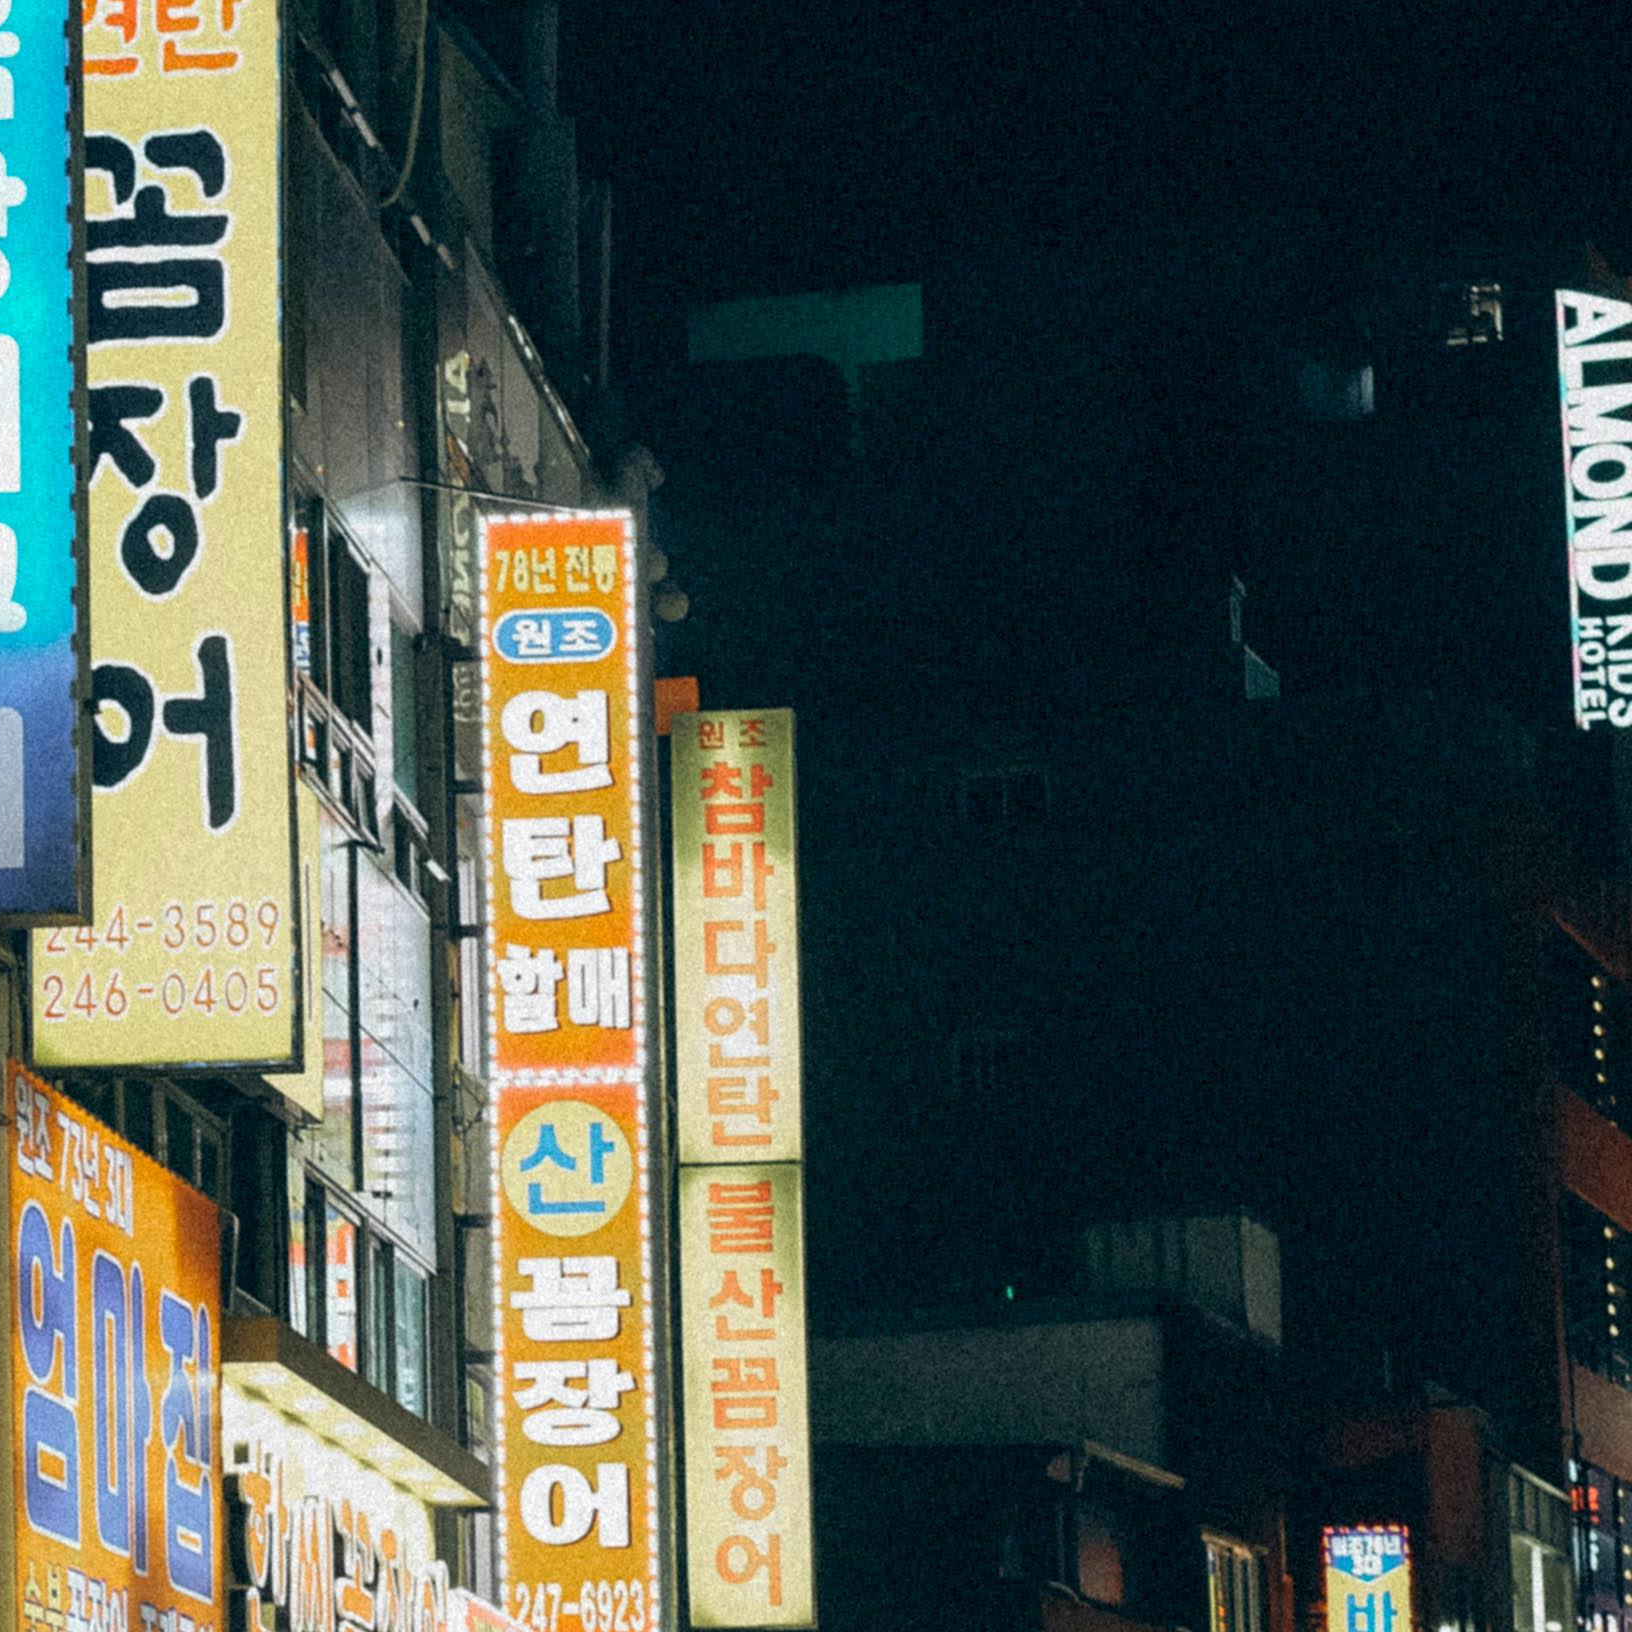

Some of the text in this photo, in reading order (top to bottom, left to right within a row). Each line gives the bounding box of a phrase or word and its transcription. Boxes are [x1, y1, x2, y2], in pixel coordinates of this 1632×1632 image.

[1563, 288, 1632, 601] ALMOND
[494, 540, 618, 598] 78년 전통
[510, 615, 604, 658] 원조
[1576, 616, 1608, 731] HOTEL
[1605, 612, 1632, 730] KIDS
[40, 902, 281, 955] 244-3589
[40, 968, 282, 1021] 246-0405
[14, 1075, 134, 1238] 원조 73년 3대
[517, 1120, 616, 1218] 산
[16, 1197, 216, 1607] 엄마집
